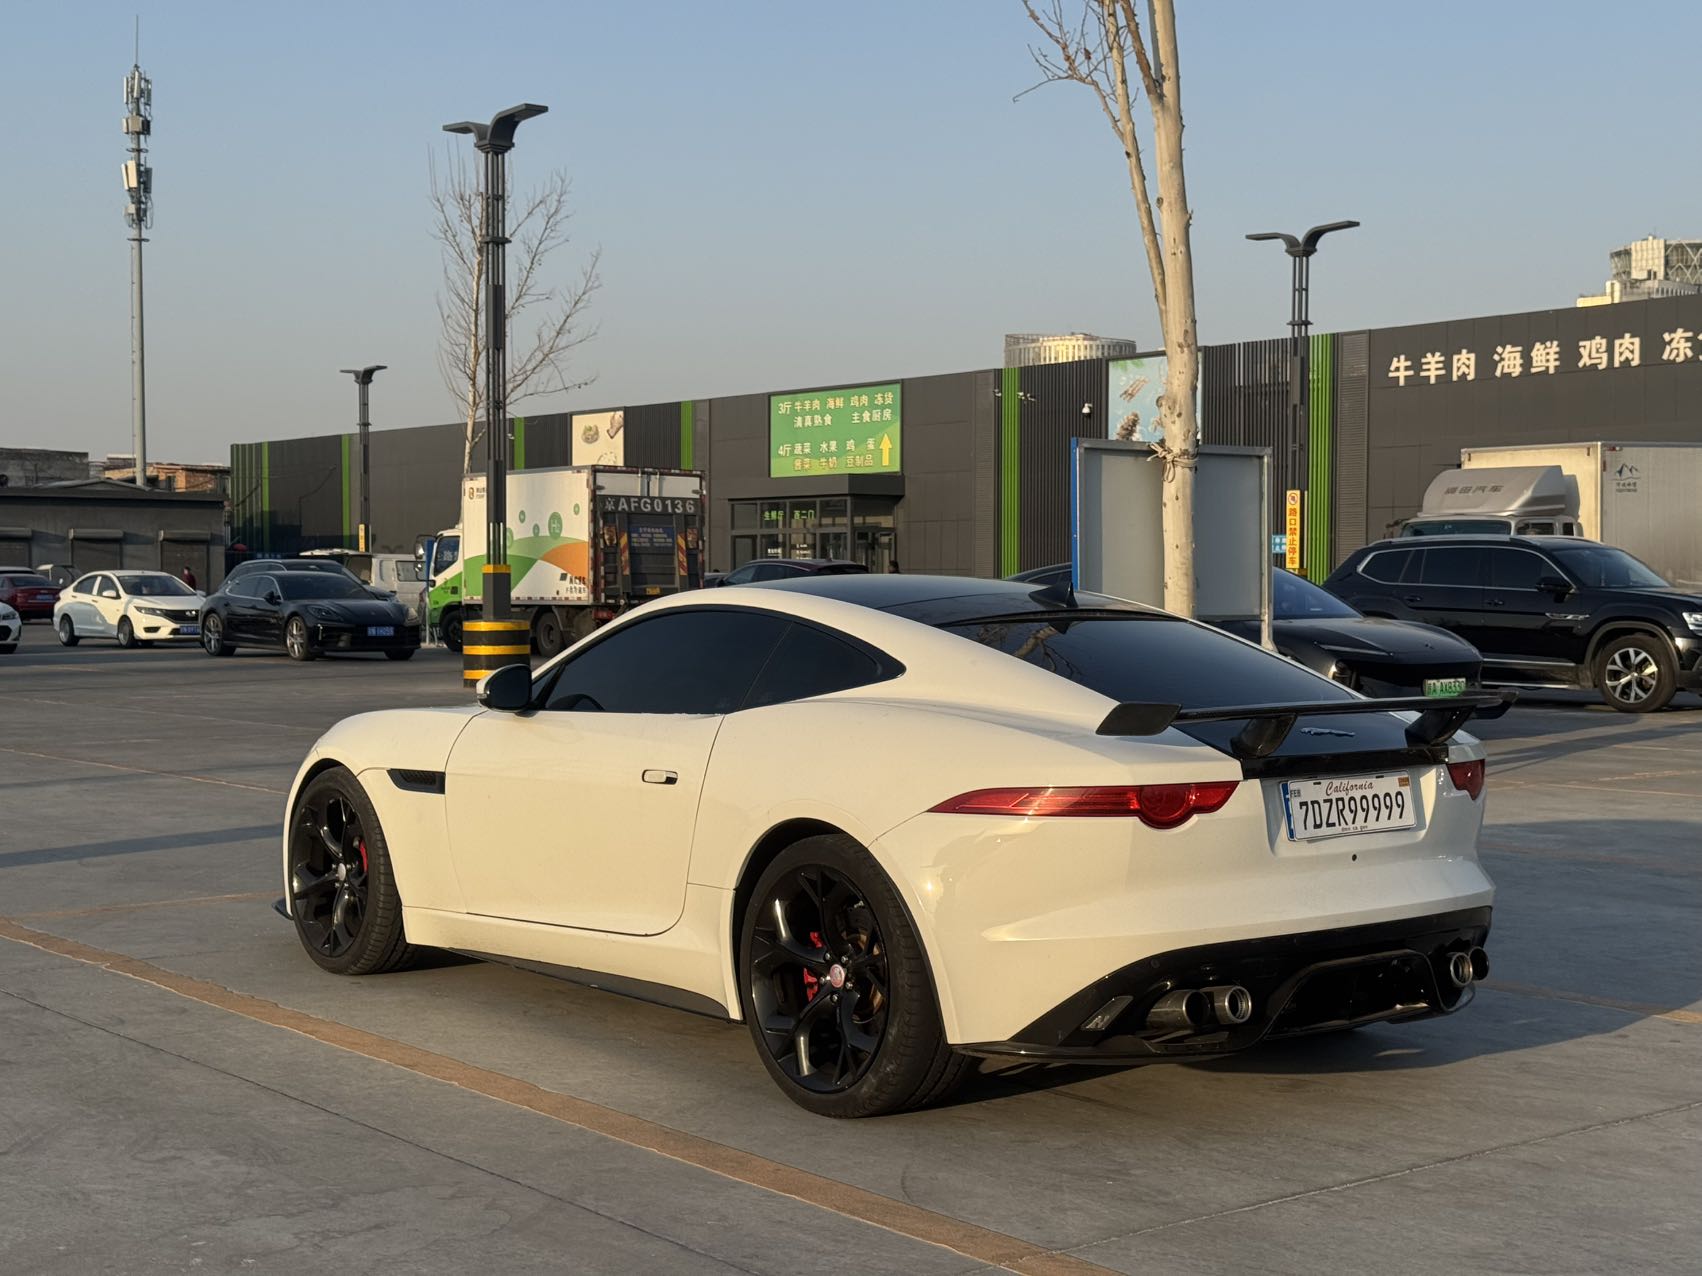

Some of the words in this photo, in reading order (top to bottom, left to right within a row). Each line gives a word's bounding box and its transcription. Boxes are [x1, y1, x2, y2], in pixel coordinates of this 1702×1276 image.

[1388, 349, 1476, 386] 牛羊肉
[1493, 340, 1560, 378] 海鲜
[1578, 333, 1641, 370] 鸡肉
[1661, 328, 1702, 363] 冻
[794, 399, 821, 412] 牛羊肉
[826, 397, 844, 409] 海鲜
[850, 395, 868, 407] 鸡肉
[874, 392, 894, 405] 冻货
[851, 408, 892, 424] 主食厨房
[794, 442, 811, 455] 蔬菜
[820, 440, 838, 453] 水果
[846, 454, 873, 468] 豆制品
[1325, 780, 1374, 796] California
[1299, 790, 1405, 830] 7DZR99999
